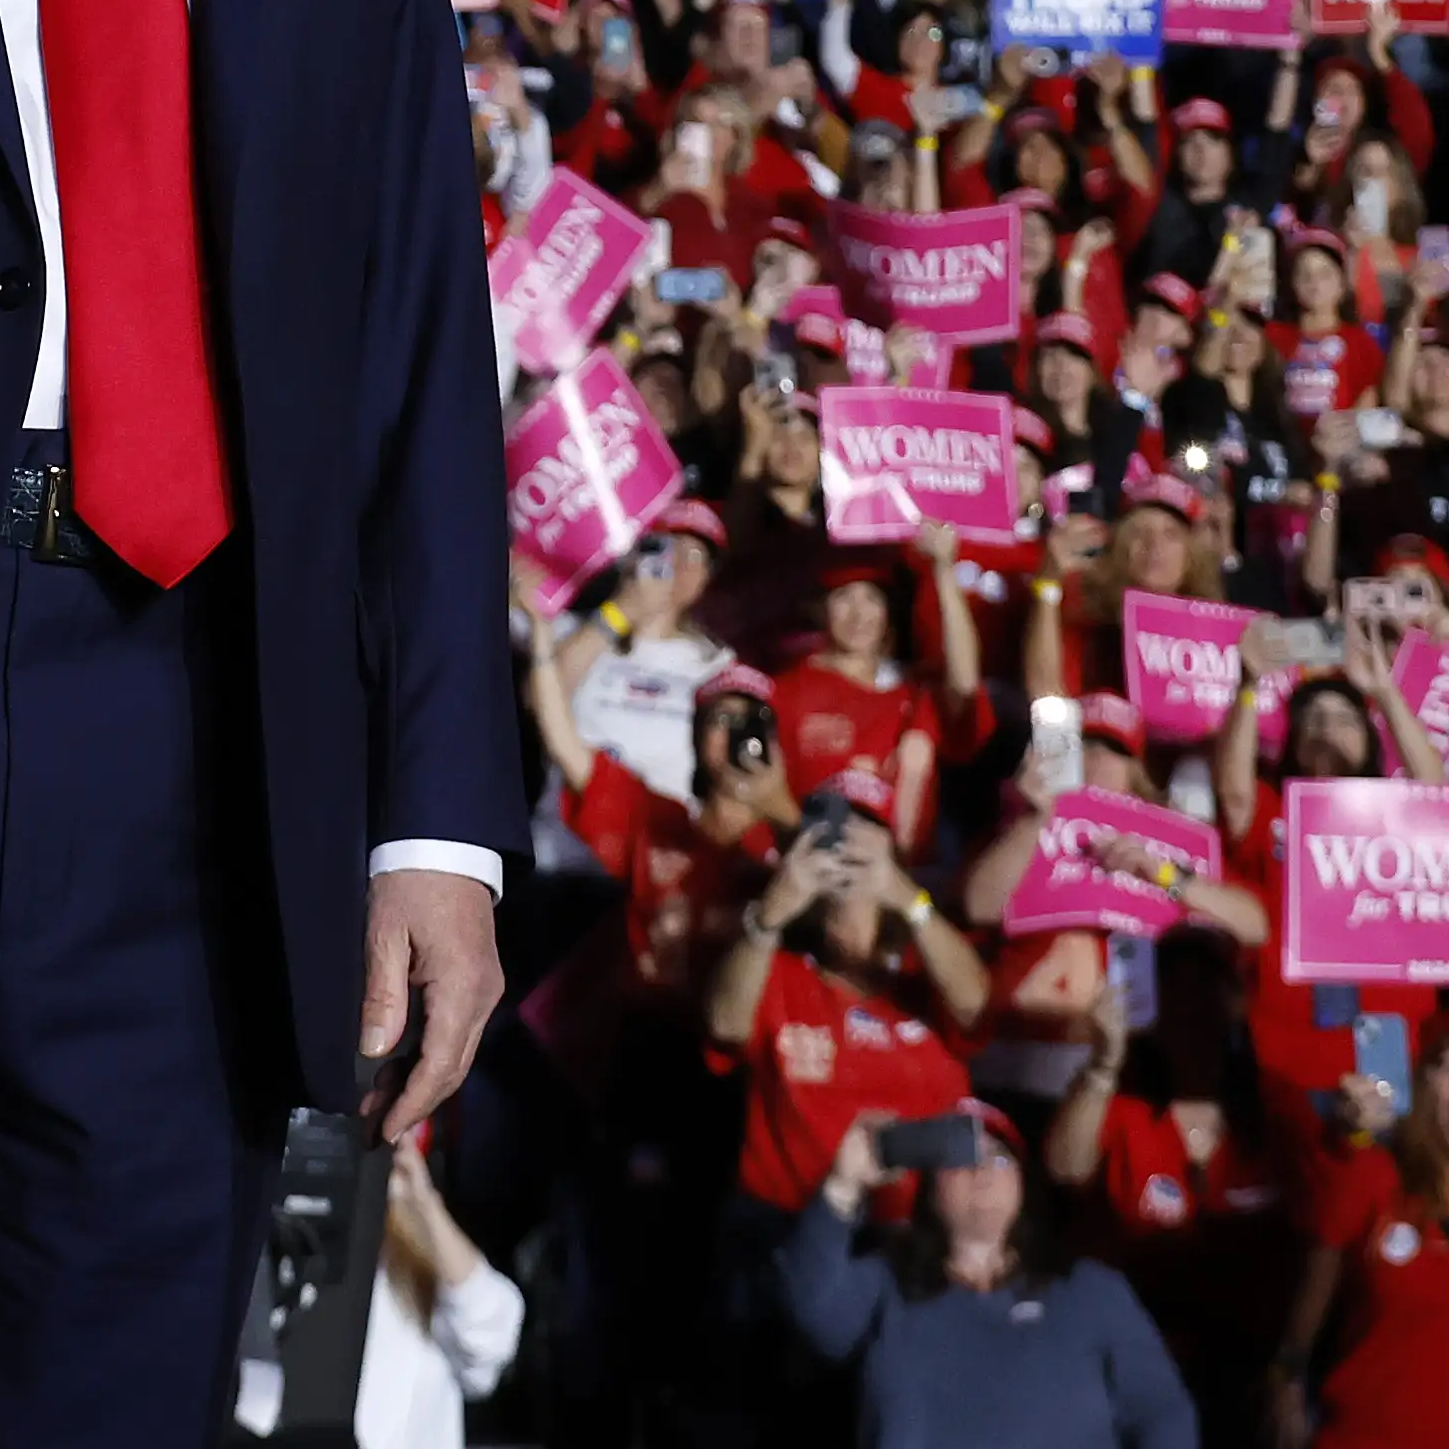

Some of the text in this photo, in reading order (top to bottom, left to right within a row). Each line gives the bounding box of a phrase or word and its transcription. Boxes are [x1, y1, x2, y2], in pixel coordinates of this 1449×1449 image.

[837, 424, 1002, 474] WOMEN
[1136, 631, 1243, 685] WOM
[1346, 889, 1390, 929] for
